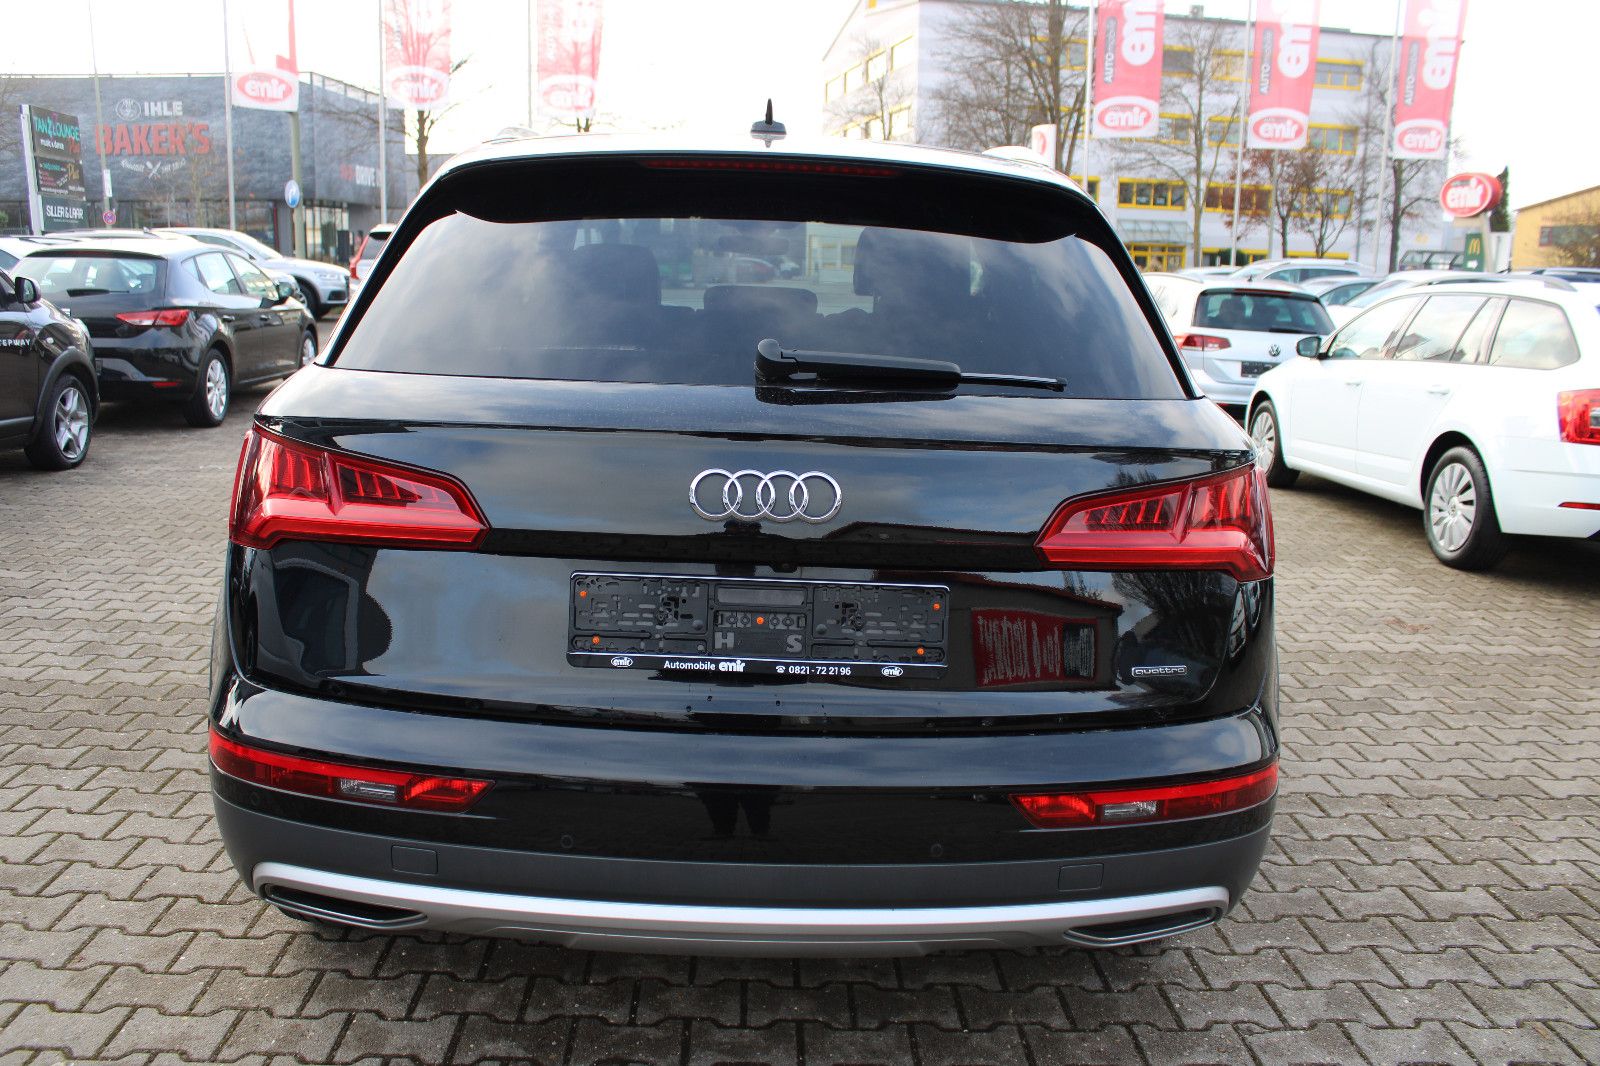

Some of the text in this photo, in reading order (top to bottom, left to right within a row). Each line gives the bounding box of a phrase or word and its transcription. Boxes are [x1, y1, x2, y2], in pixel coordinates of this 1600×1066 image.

[244, 79, 286, 99] emir
[144, 101, 183, 117] IHLE
[1104, 107, 1147, 127] emir
[1259, 120, 1298, 139] emir
[95, 122, 210, 156] BAKER'S
[1403, 131, 1440, 149] emir
[1446, 177, 1483, 208] emir
[612, 658, 632, 667] emir
[663, 659, 746, 672] Automobile emir
[883, 667, 902, 676] emir
[1135, 667, 1185, 676] quattro
